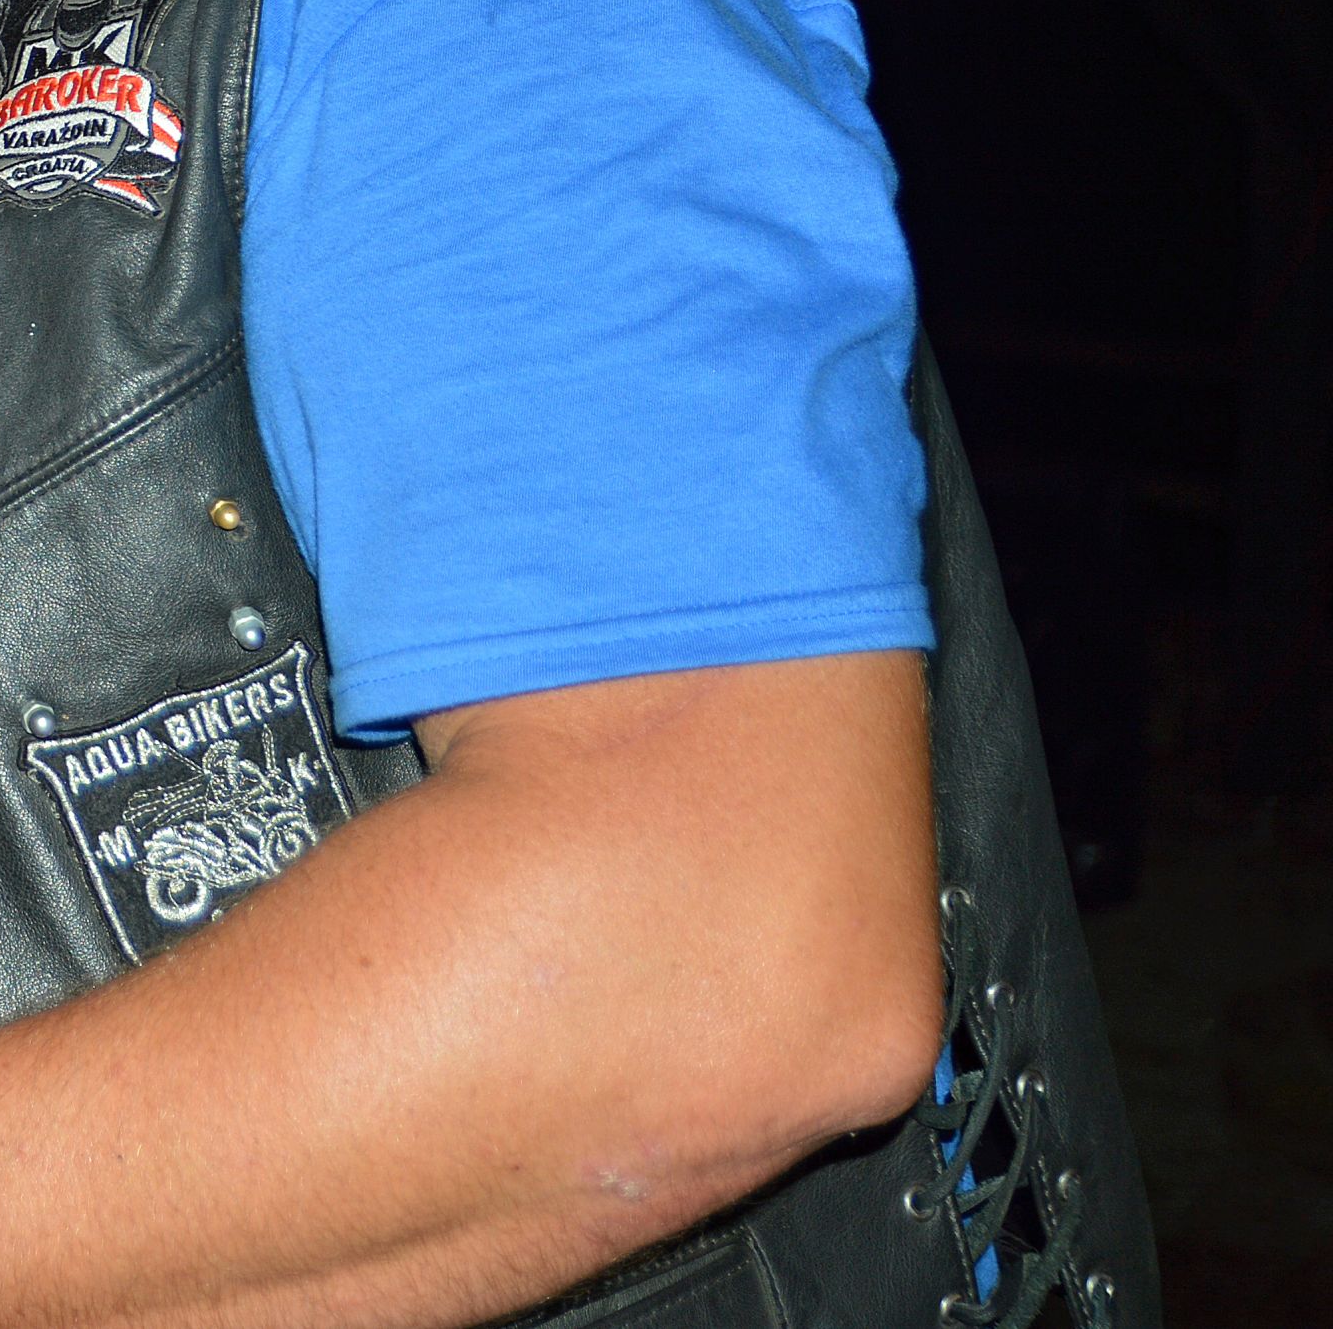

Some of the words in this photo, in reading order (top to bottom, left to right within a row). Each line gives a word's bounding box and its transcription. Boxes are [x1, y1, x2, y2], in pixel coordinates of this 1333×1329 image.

[2, 117, 108, 150] VARAŽDIN
[65, 727, 163, 794] AQUA
[164, 673, 295, 749] BIKERS
